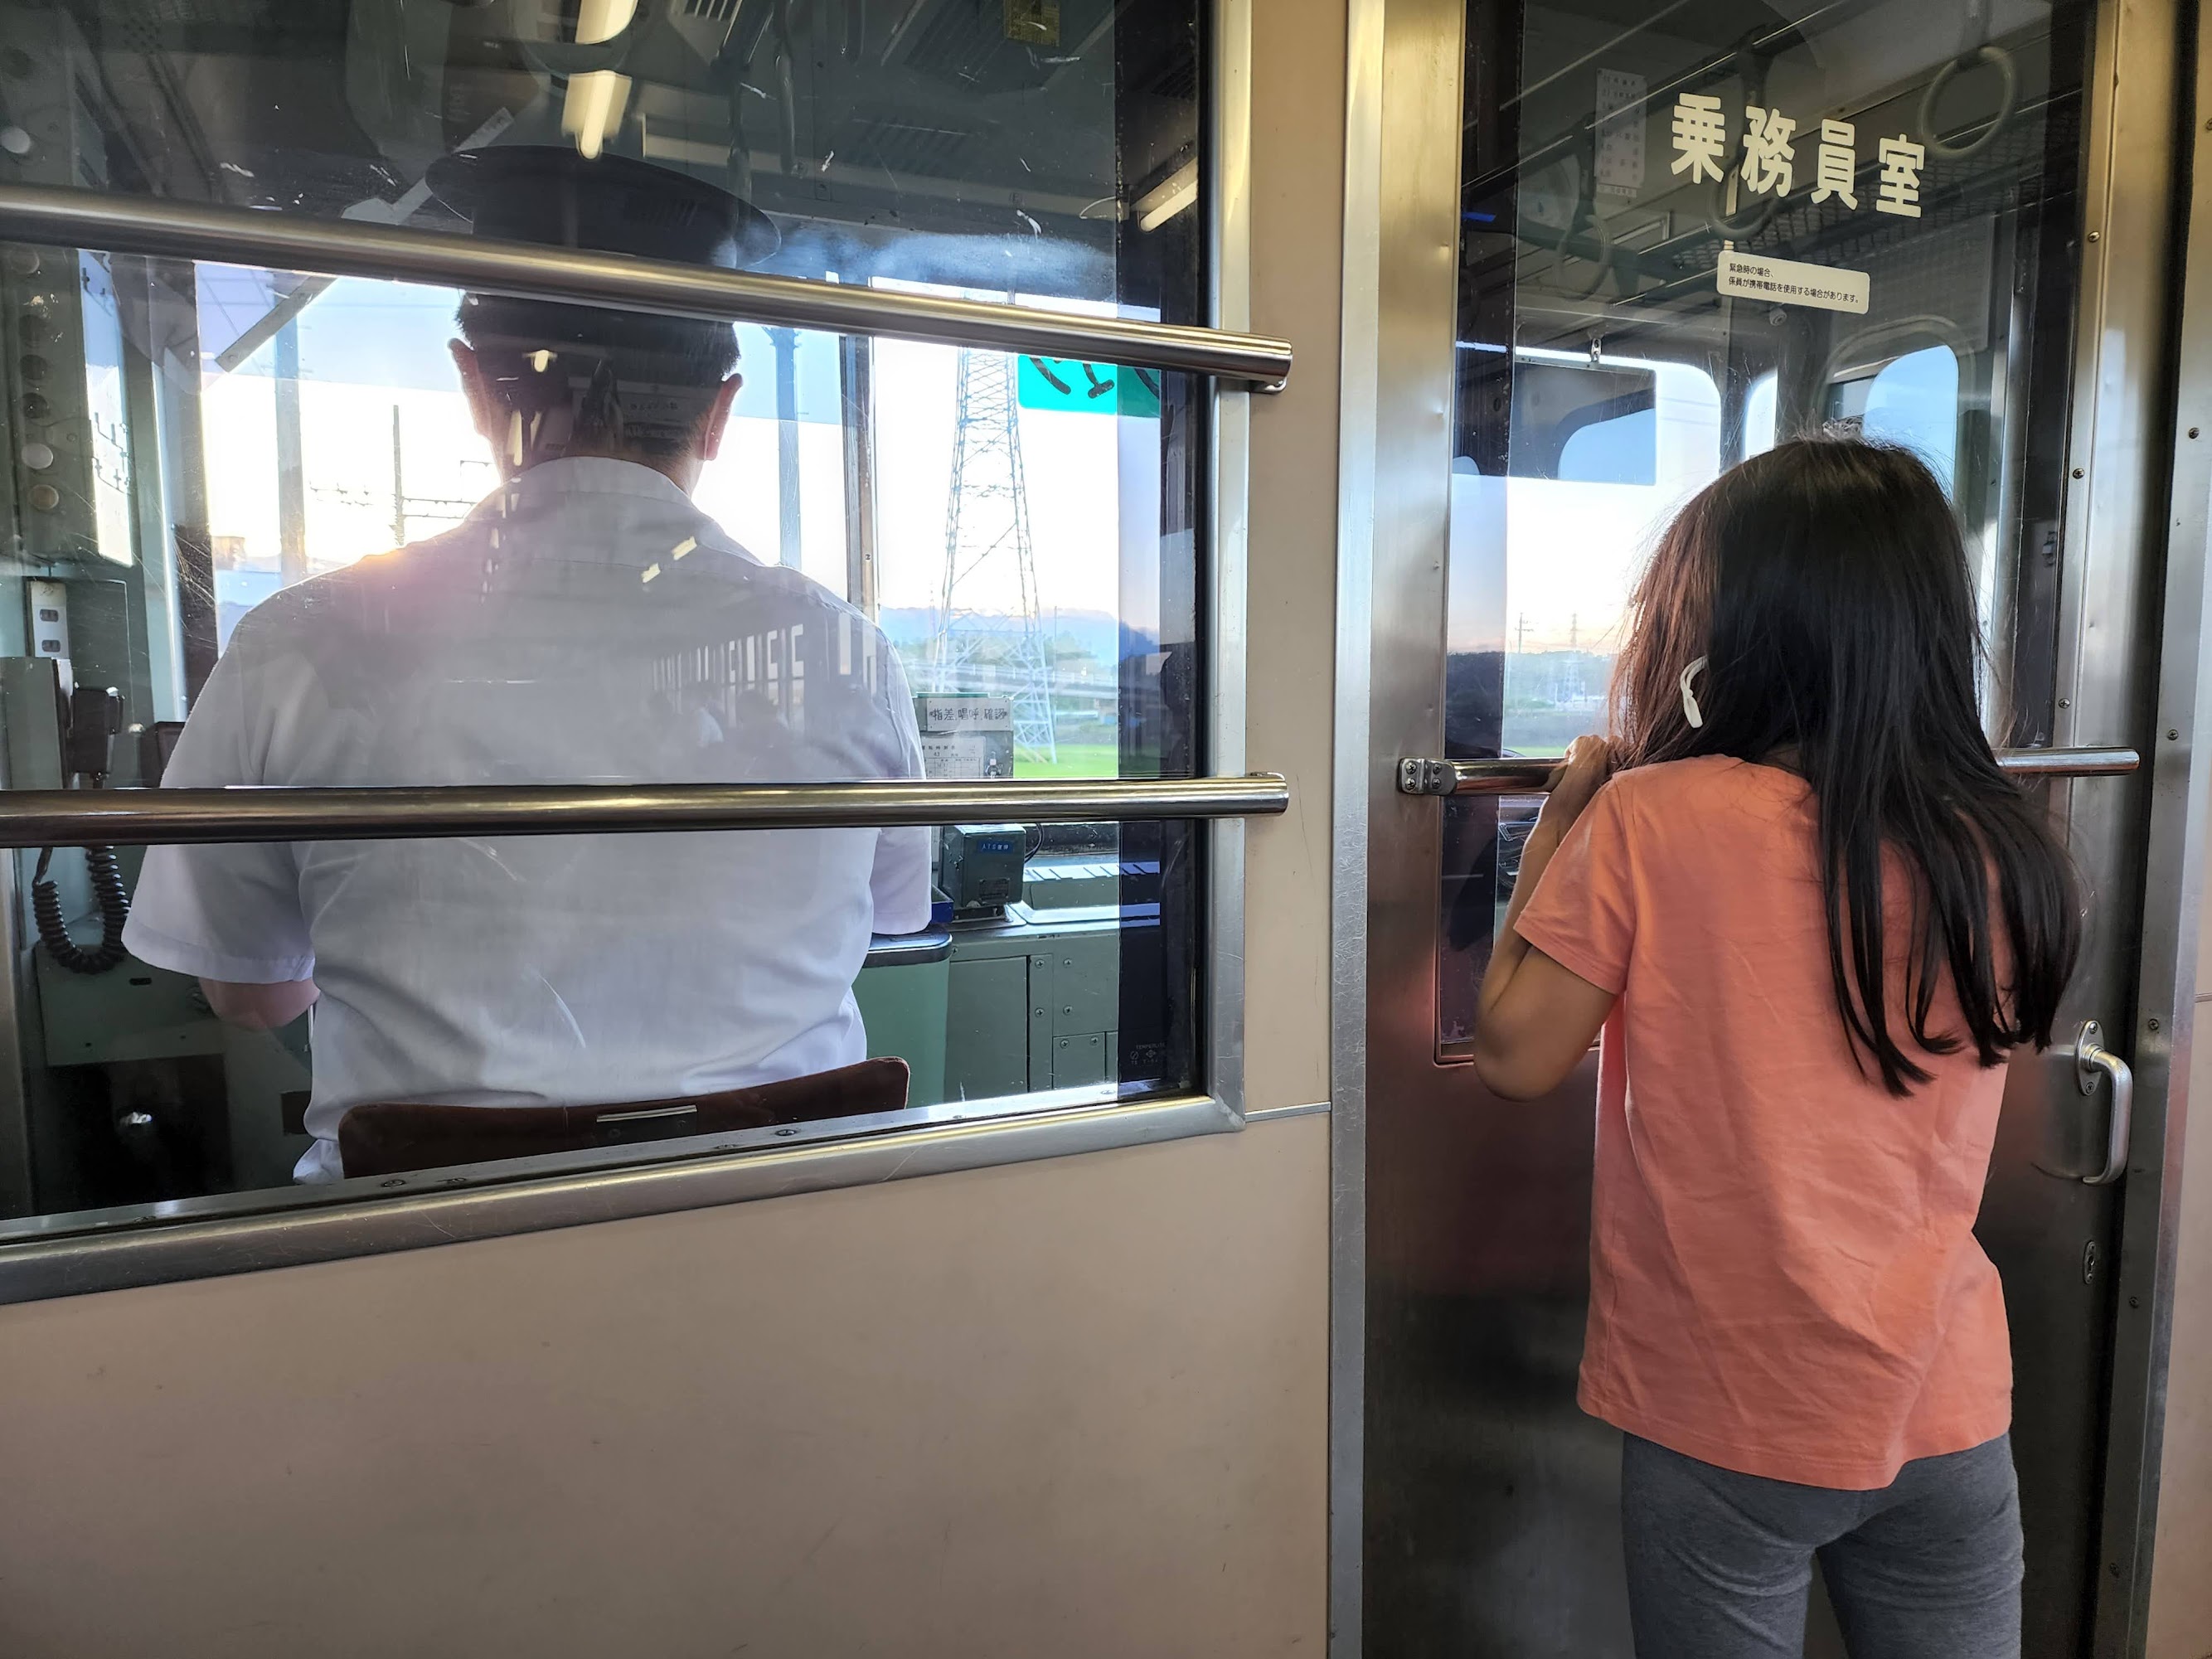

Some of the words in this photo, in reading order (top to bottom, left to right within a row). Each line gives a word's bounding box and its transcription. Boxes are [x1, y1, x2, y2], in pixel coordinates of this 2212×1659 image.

[1671, 92, 1925, 218] 乗務員室
[1729, 263, 1774, 279] 緊急時の場合、
[1728, 276, 1860, 303] 係員が携帯電話を使用する場合があります。
